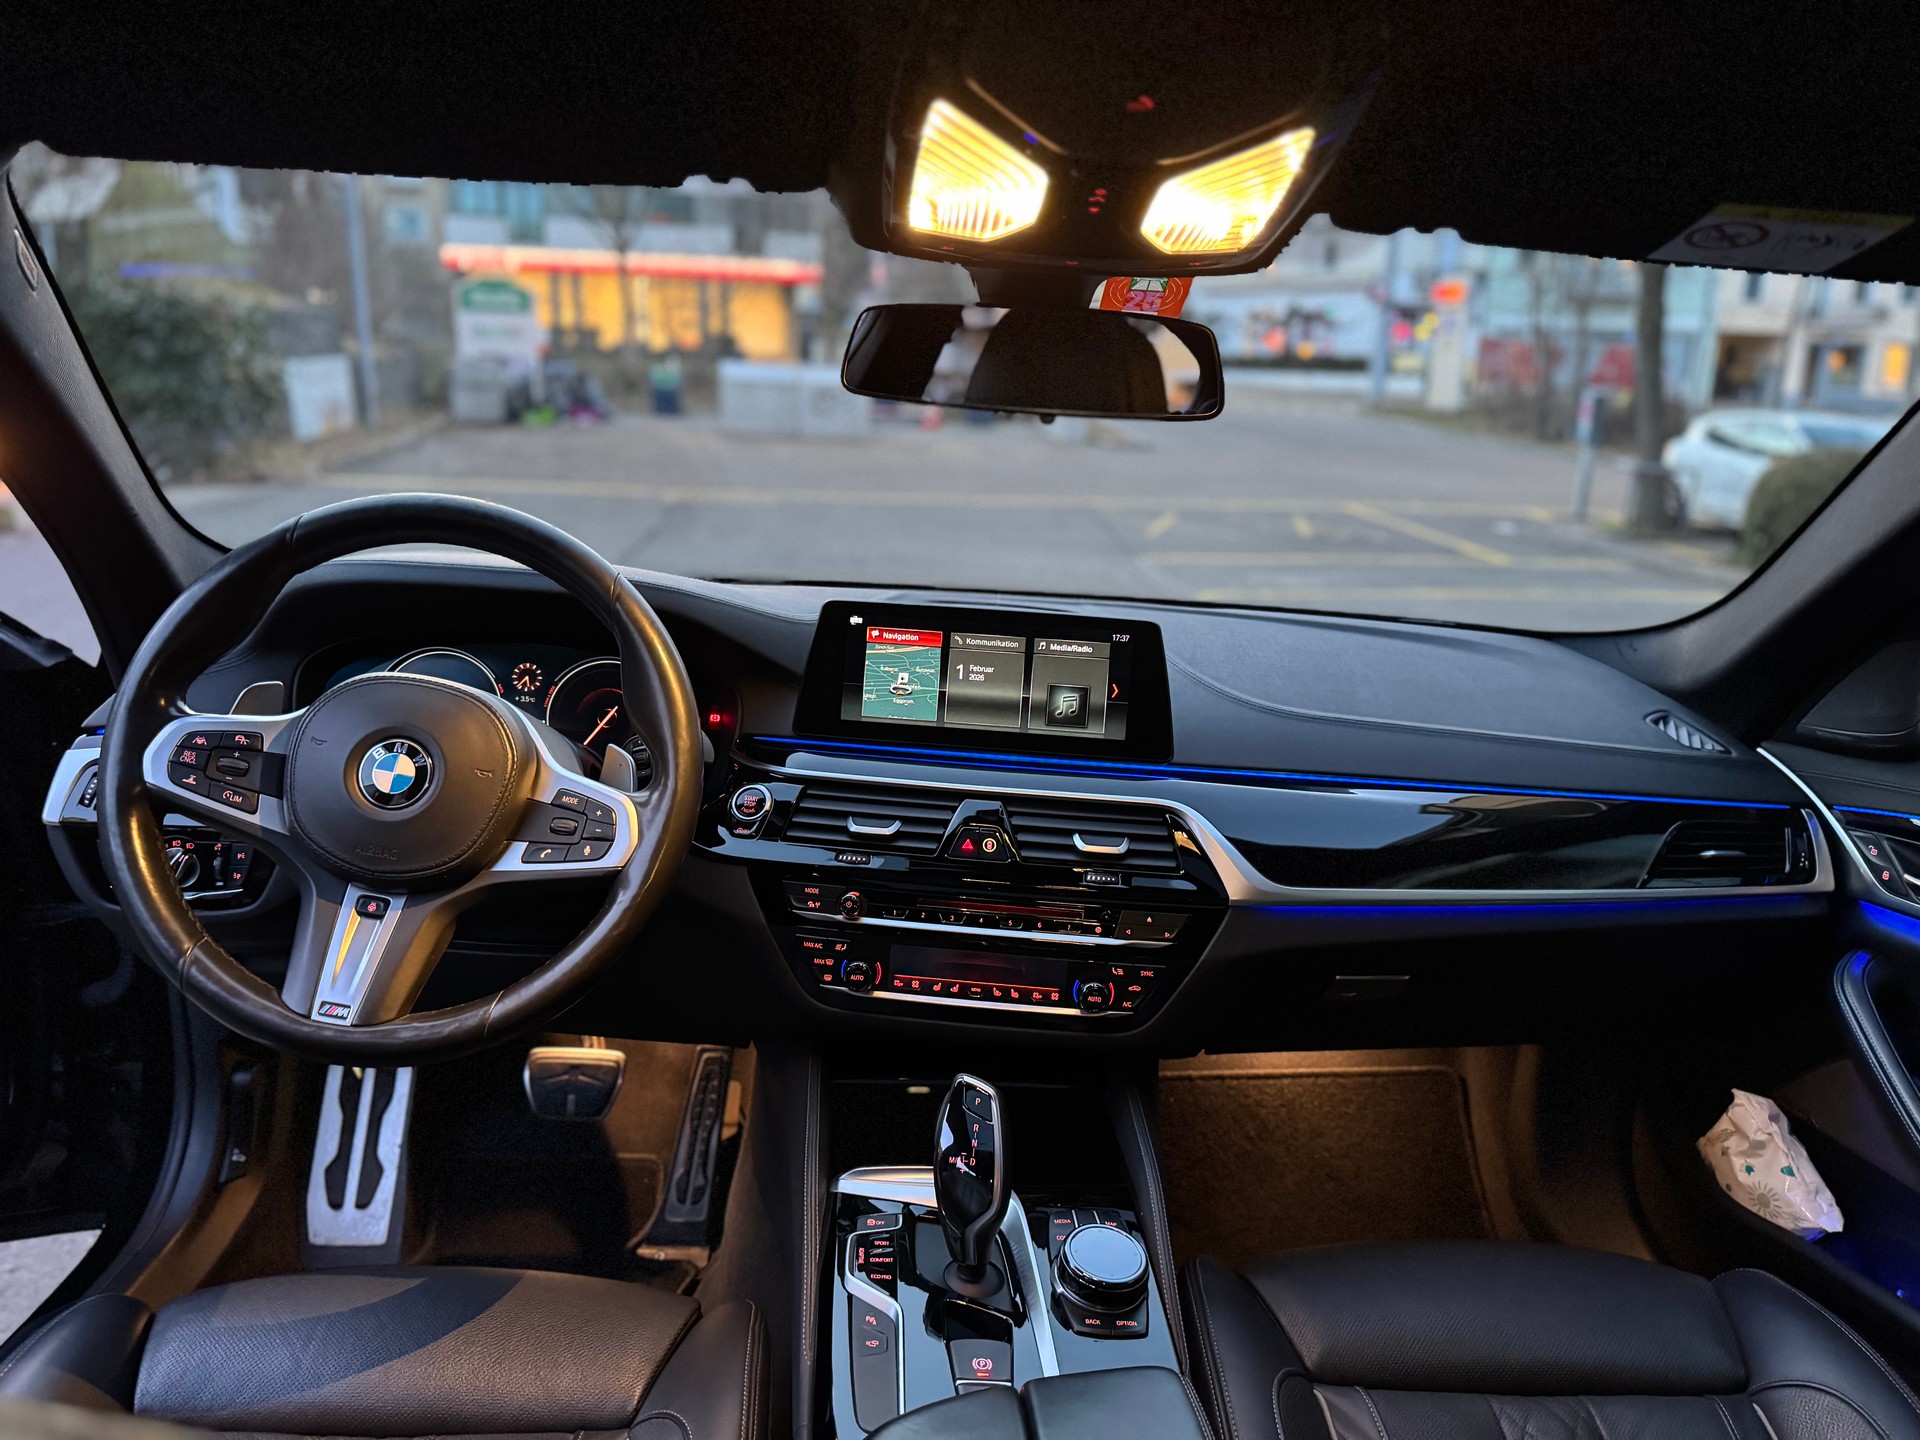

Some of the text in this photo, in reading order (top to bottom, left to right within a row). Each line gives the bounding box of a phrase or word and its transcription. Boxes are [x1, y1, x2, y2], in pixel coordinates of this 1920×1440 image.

[883, 632, 919, 641] Navigation
[1112, 634, 1130, 642] 17:37
[966, 638, 1019, 648] Kommunikation
[1050, 643, 1093, 653] Media/Radio
[956, 664, 995, 680] 1 Februar
[969, 673, 985, 681] 2026
[372, 742, 427, 767] BMW
[180, 756, 196, 764] CNCL
[230, 793, 243, 803] LIM
[561, 795, 579, 805] MODE
[1087, 995, 1102, 1003] AUTO
[975, 1097, 981, 1106] P
[973, 1123, 979, 1132] R
[971, 1139, 978, 1148] N
[970, 1158, 976, 1166] D
